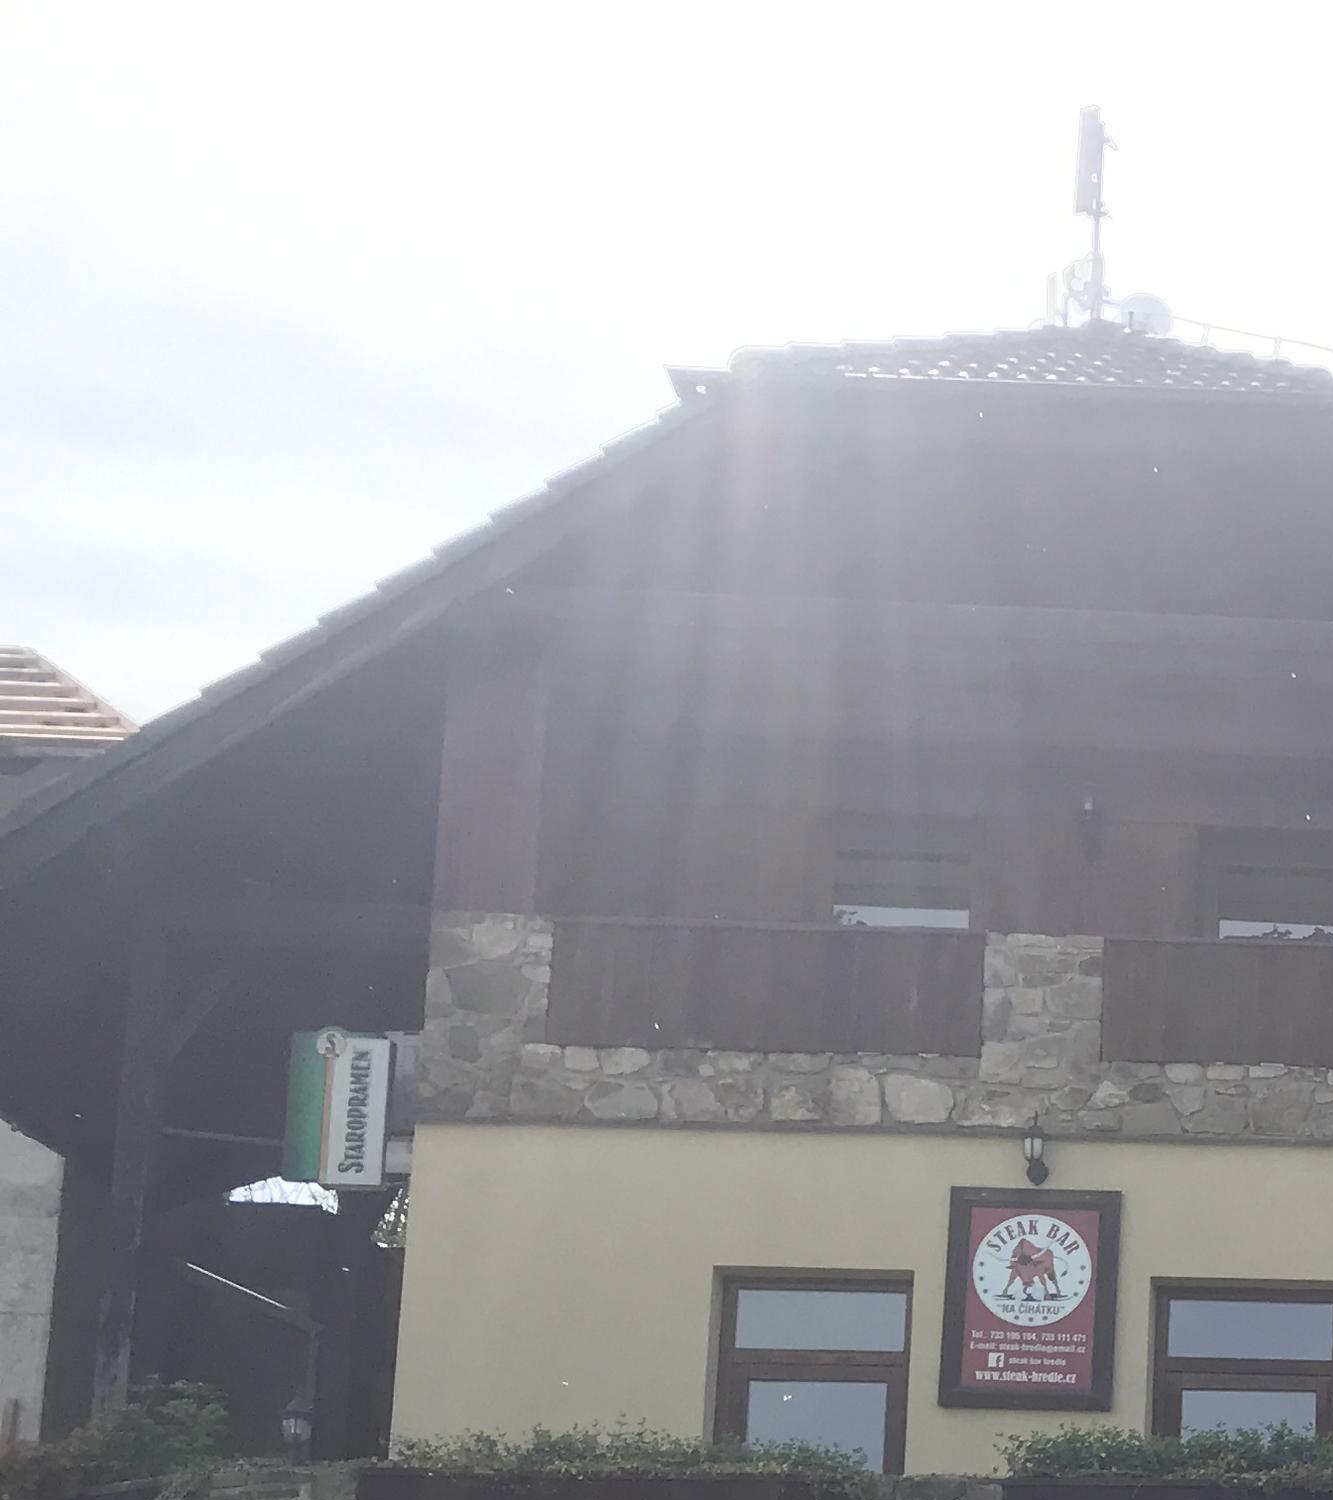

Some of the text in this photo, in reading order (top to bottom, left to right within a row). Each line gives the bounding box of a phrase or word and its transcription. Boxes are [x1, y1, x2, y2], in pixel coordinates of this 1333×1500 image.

[338, 1050, 370, 1174] STAROPRAMEN
[986, 1219, 1080, 1255] STEAK BAR
[975, 1370, 1077, 1384] www.steak-hredle.cz
